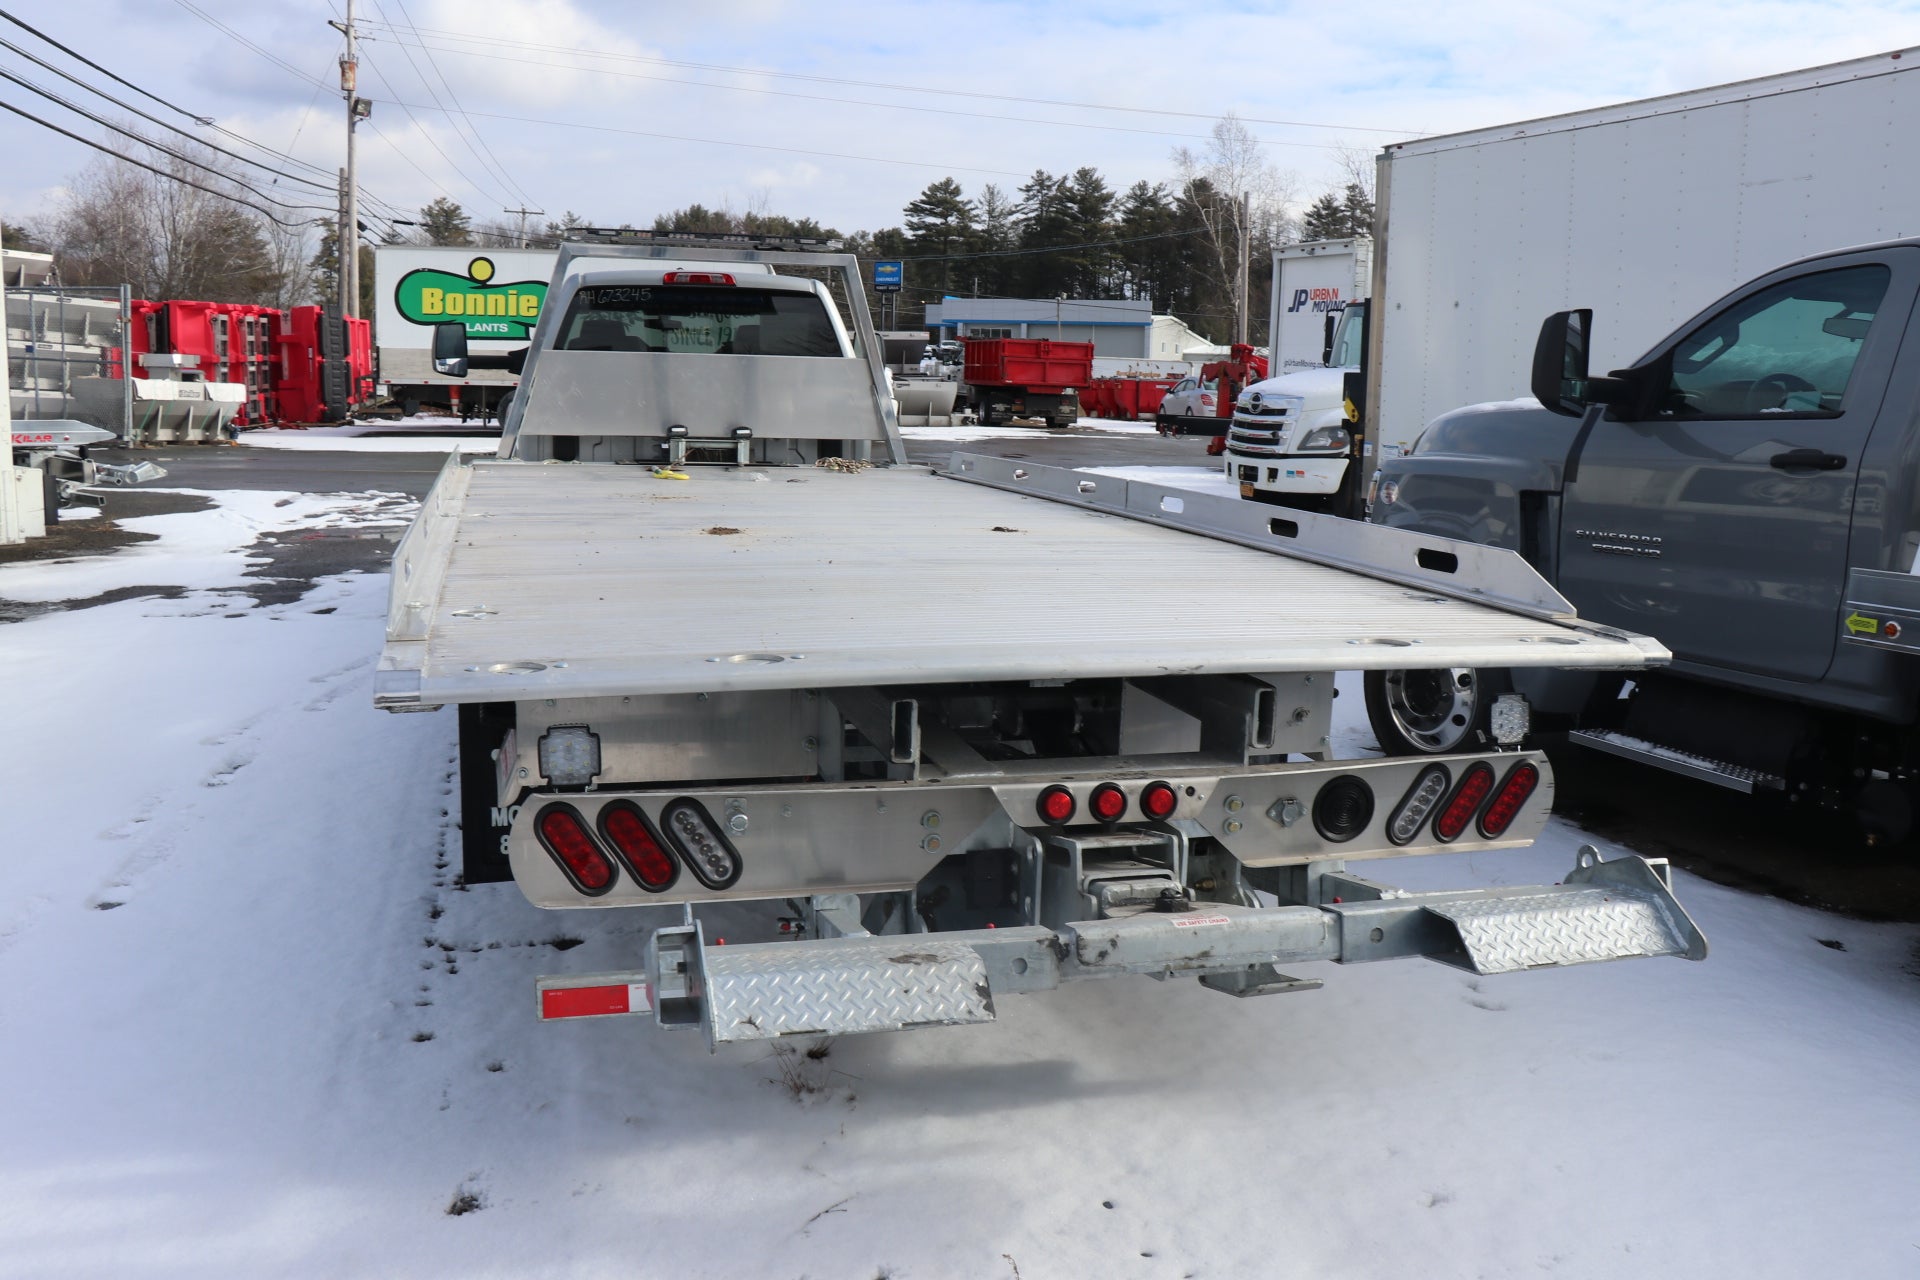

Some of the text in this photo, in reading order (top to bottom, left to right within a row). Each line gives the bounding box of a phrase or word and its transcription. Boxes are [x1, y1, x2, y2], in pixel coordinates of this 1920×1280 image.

[422, 288, 538, 316] Bonnie
[1287, 287, 1339, 313] JP URBAN
[465, 322, 508, 332] LANTS
